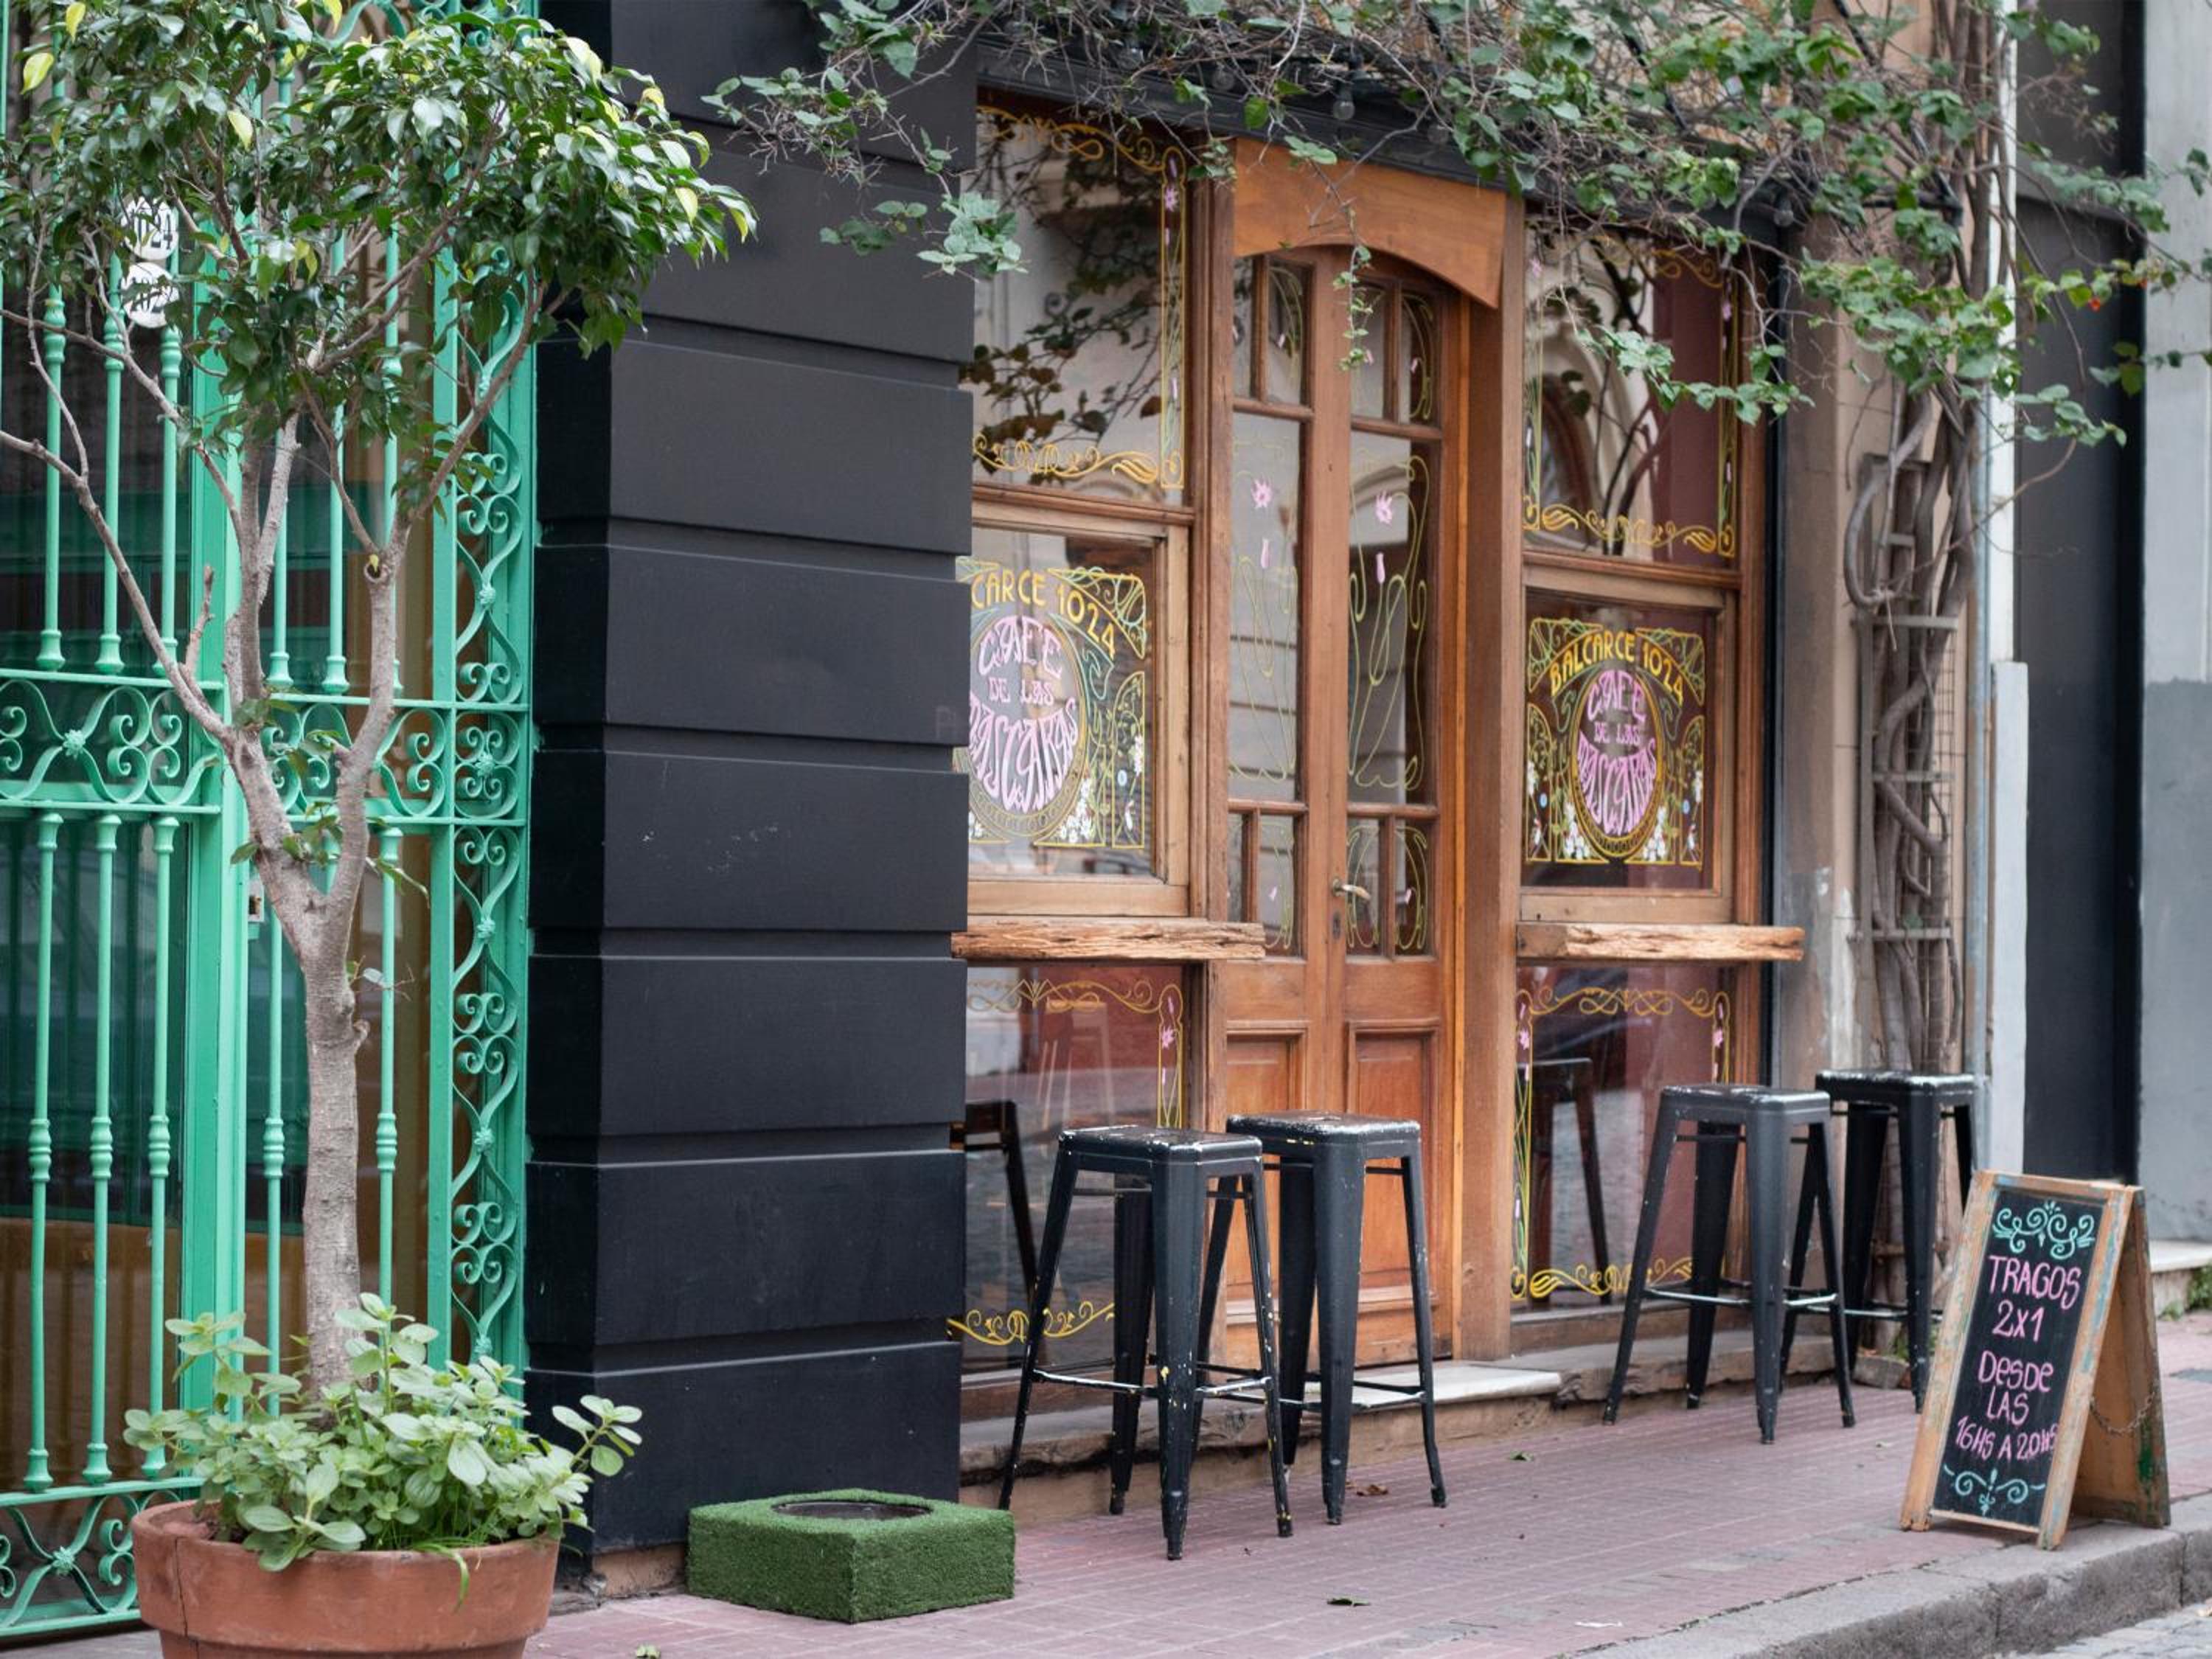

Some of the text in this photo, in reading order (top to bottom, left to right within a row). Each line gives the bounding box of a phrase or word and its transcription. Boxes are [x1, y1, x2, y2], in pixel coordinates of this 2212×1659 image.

[970, 569, 1116, 661] CARCE 1024
[988, 677, 1054, 706] DE LAS
[1550, 630, 1683, 708] BALCARCE 1024
[1594, 721, 1641, 745] DE LAS
[1989, 1255, 2081, 1310] TRAGOS
[1986, 1385, 2028, 1426] LAS
[1955, 1416, 1995, 1461] 16HS
[1998, 1434, 2011, 1461] A
